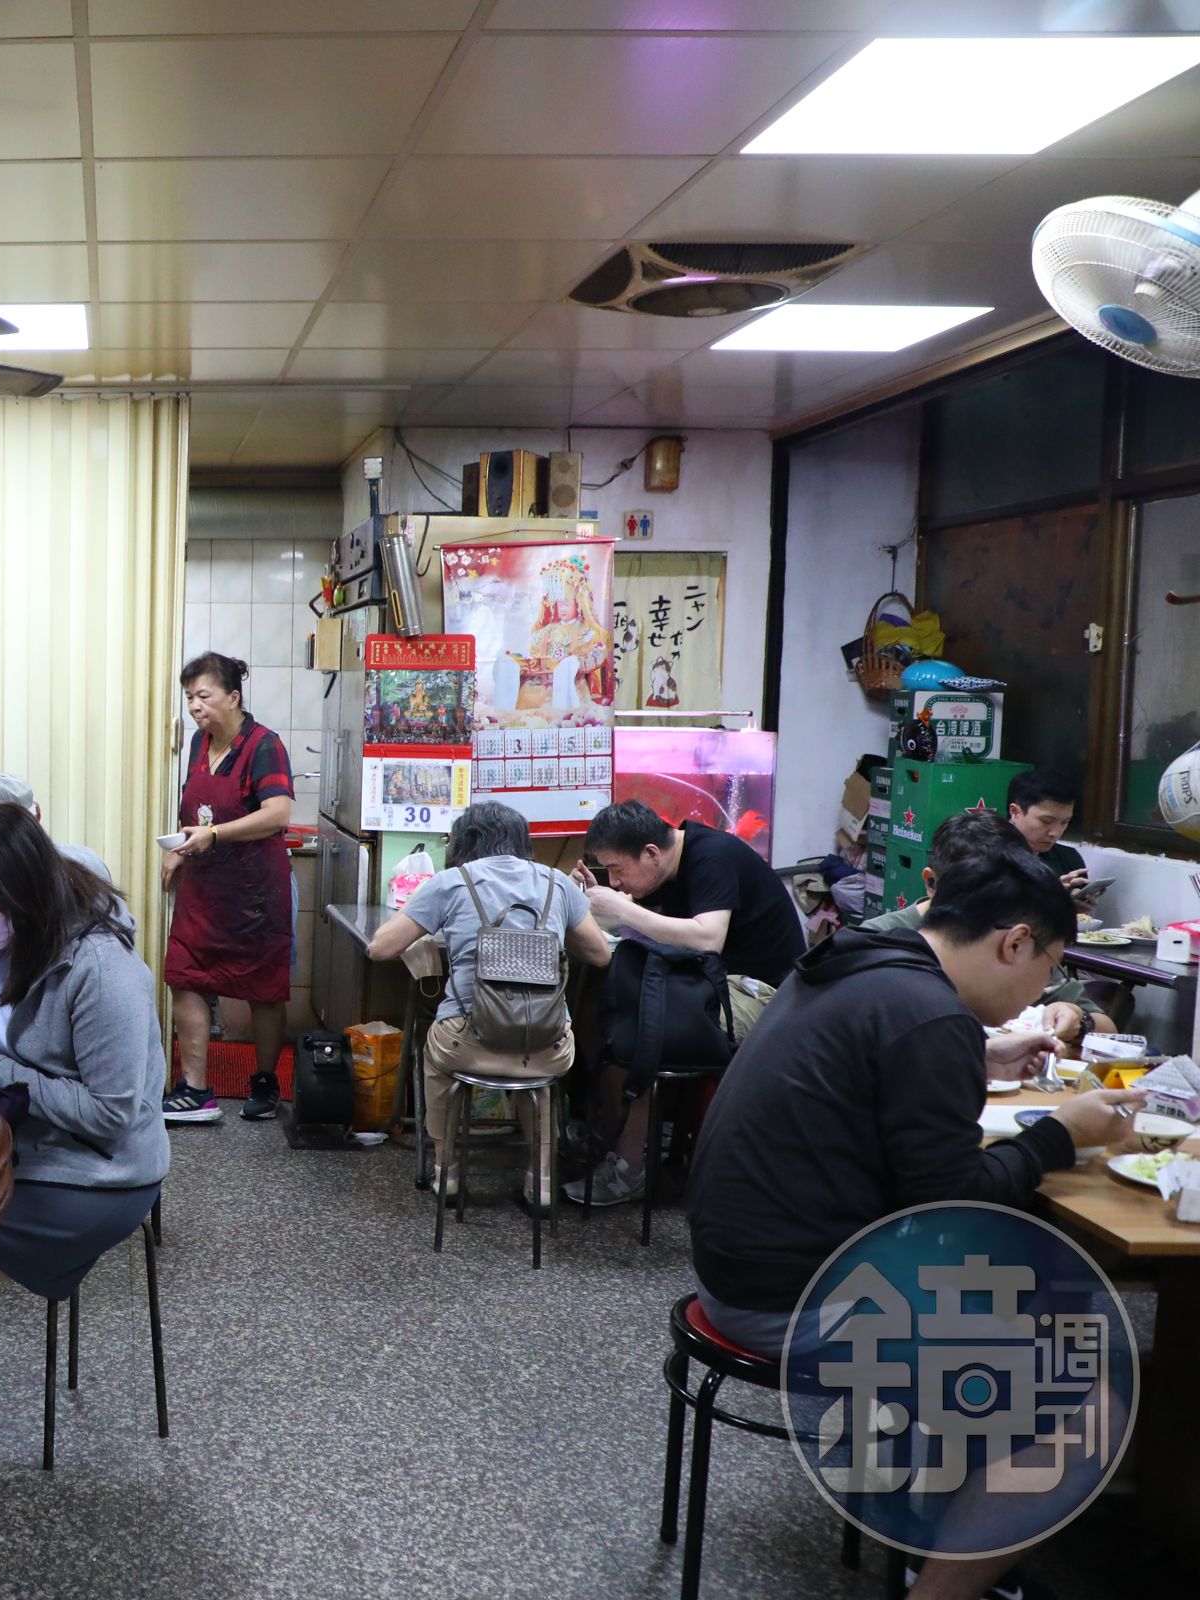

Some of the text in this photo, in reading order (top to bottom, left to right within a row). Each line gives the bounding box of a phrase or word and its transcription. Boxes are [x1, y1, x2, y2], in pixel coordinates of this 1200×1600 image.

[648, 595, 671, 647] 幸せ
[514, 739, 522, 754] 3
[567, 736, 576, 753] 5
[594, 735, 601, 749] 6
[566, 767, 577, 782] 11
[404, 806, 431, 823] 30
[893, 824, 923, 842] Heineken
